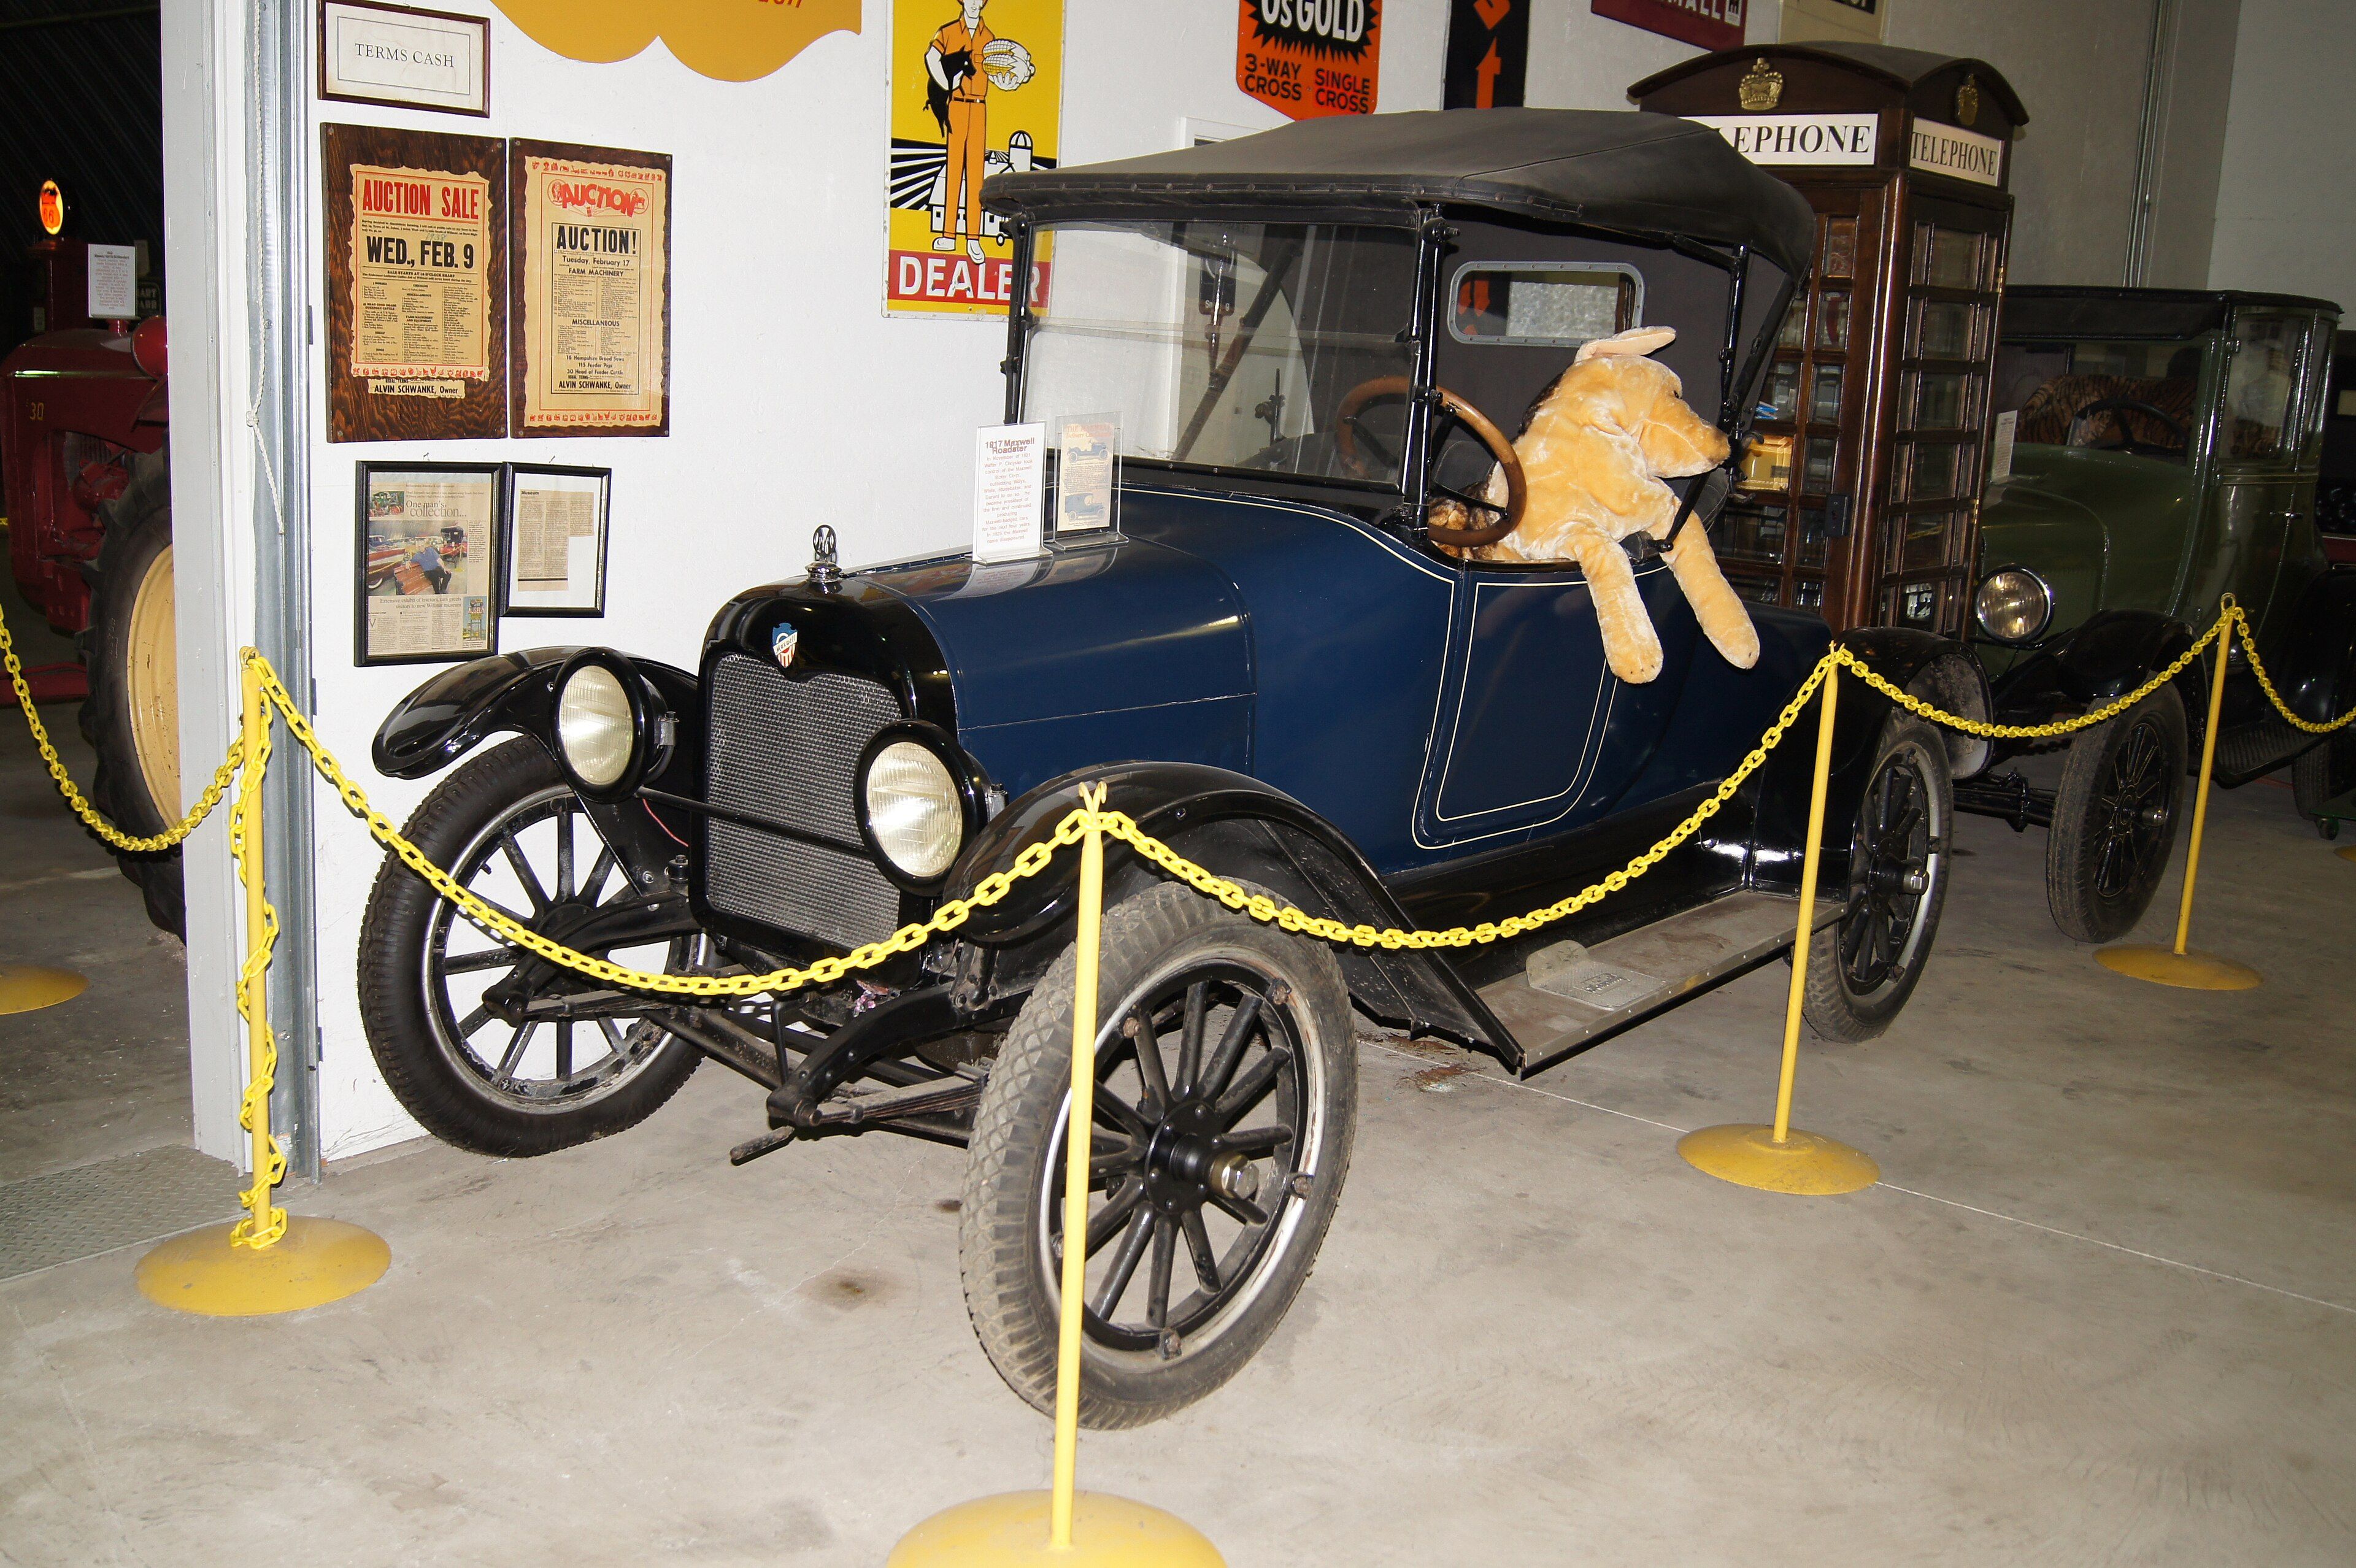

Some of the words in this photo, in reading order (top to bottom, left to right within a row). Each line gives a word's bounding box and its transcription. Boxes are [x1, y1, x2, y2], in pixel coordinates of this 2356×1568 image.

[355, 43, 408, 62] TERMS
[412, 51, 455, 67] CASH
[1245, 53, 1301, 80] 3-WAY
[1245, 74, 1301, 101] CROSS
[1315, 68, 1370, 95] SINGLE
[1316, 88, 1369, 113] CROSS
[1911, 131, 1996, 177] TELEPHONE
[362, 179, 431, 215] AUCTION
[441, 186, 479, 220] SALE
[561, 183, 636, 218] AUCTION
[366, 236, 415, 267] WED.,
[420, 240, 458, 268] FEB.
[463, 244, 474, 269] 9
[556, 225, 636, 255] AUCTION!
[562, 255, 590, 265] Tuesday,
[593, 257, 621, 267] February
[899, 256, 1040, 302] DEALER
[374, 385, 395, 393] ALVIN
[398, 385, 437, 394] SCHWANKE,
[579, 381, 612, 390] SCHWANKE,
[30, 402, 44, 421] 30
[985, 440, 1003, 448] 1917
[1004, 437, 1034, 447] Maxwell
[992, 445, 1027, 454] Roadster
[776, 634, 795, 653] Maxwell
